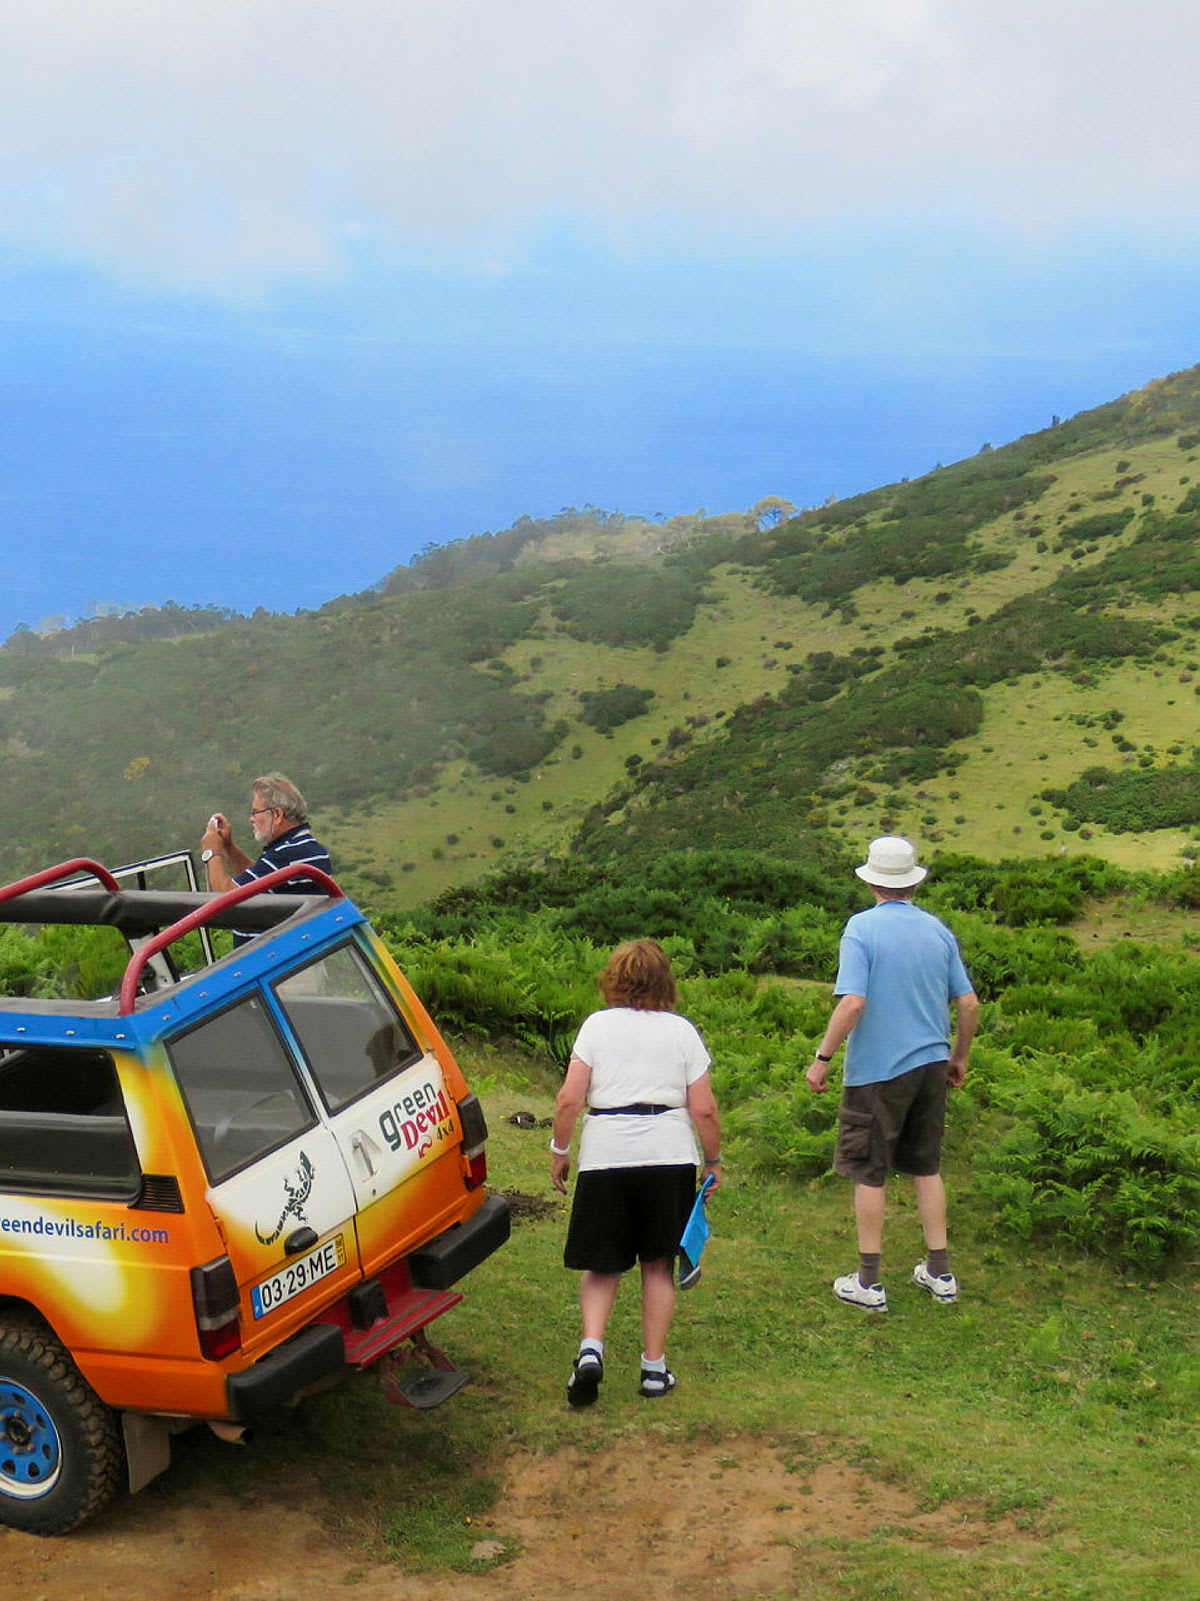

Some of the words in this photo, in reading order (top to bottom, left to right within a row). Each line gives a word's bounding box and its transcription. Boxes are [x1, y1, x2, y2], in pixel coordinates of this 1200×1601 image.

[379, 1082, 437, 1152] green
[400, 1088, 450, 1150] Devil
[437, 1118, 455, 1140] 4x4
